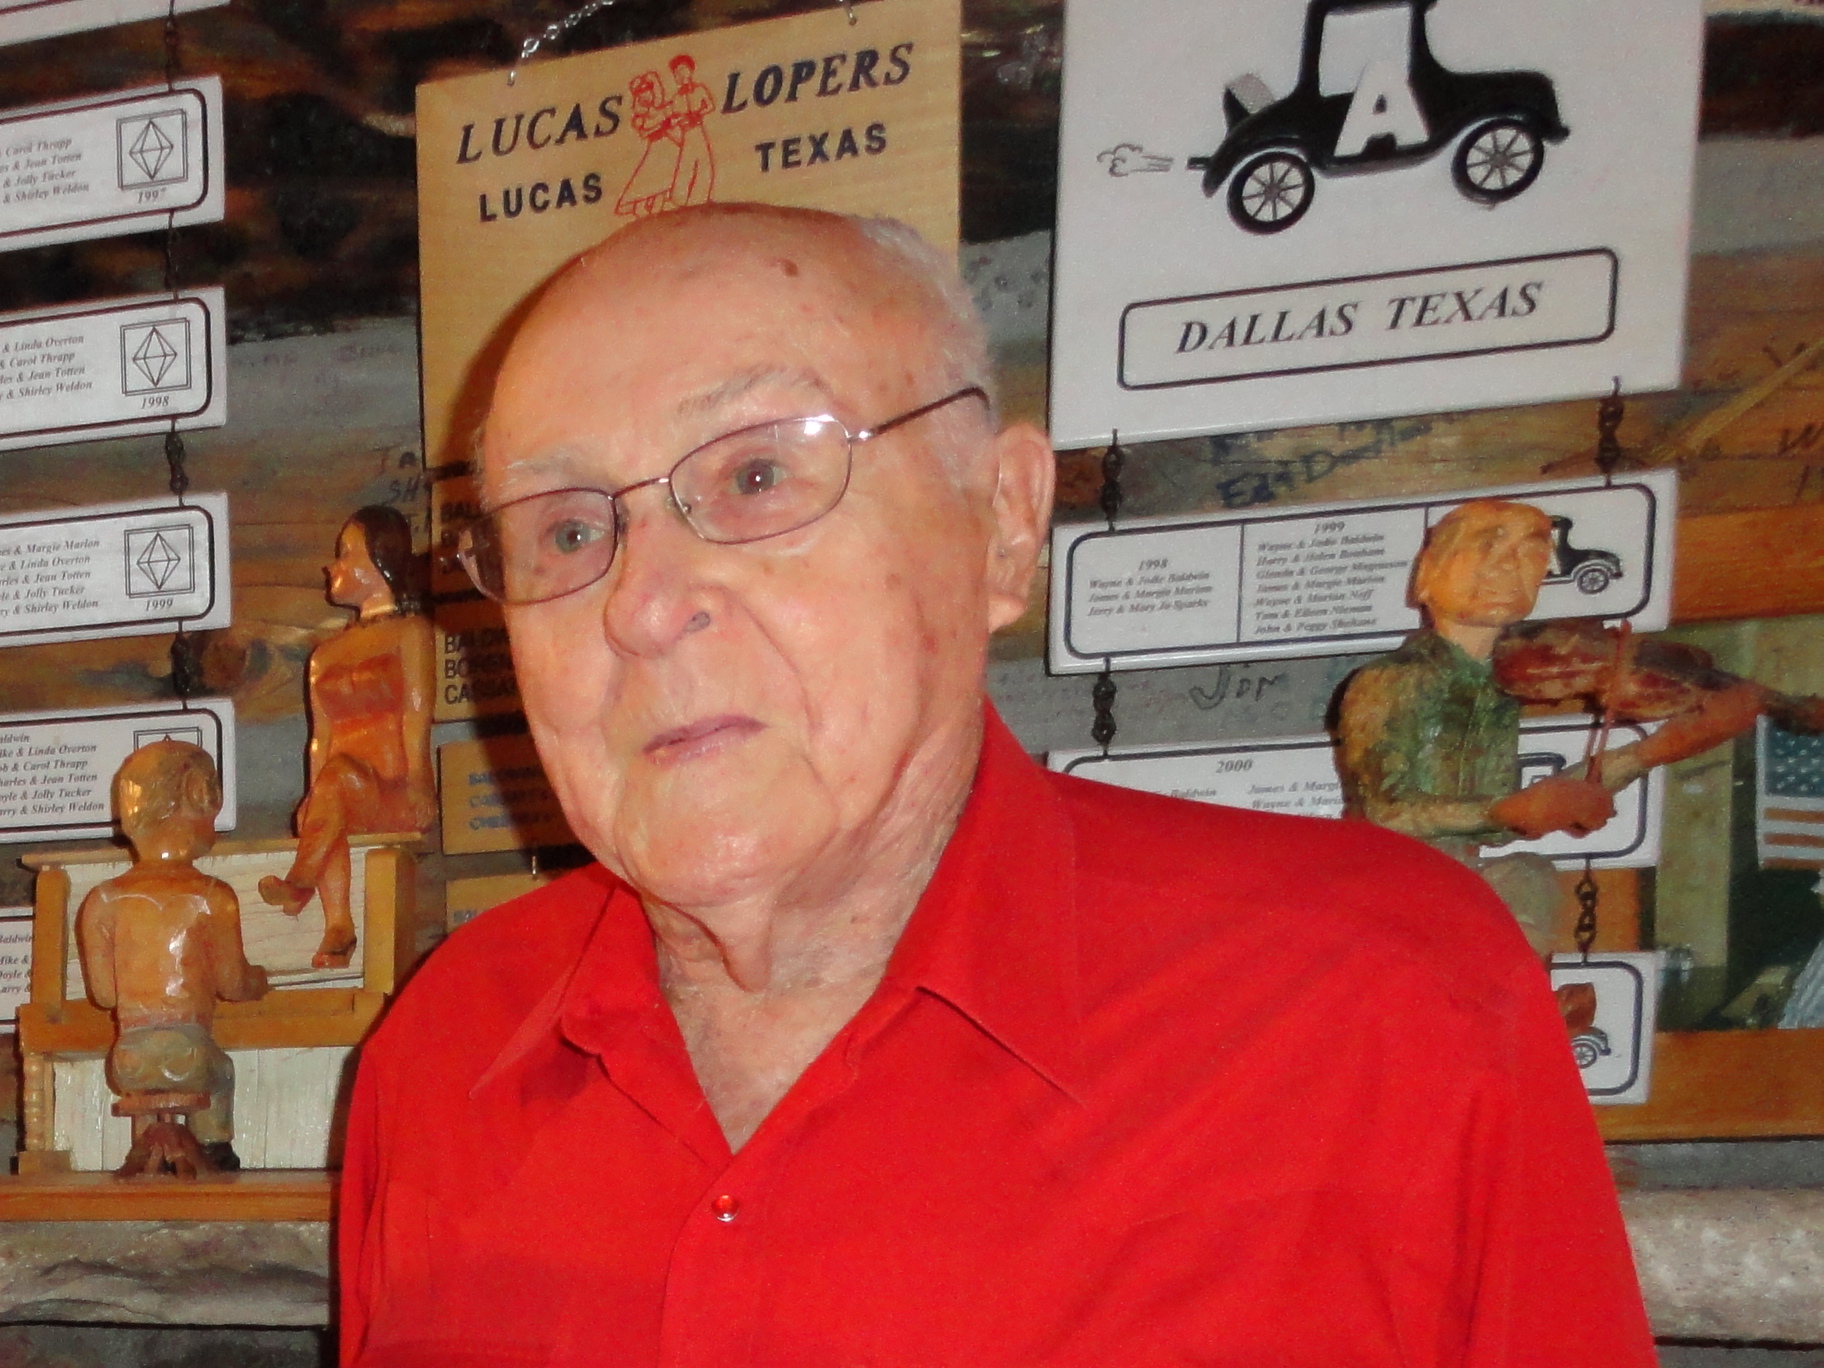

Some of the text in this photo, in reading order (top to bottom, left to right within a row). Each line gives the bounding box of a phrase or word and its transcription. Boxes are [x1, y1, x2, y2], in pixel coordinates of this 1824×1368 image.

[454, 42, 915, 165] LUCAS LOPERS
[478, 122, 889, 223] LUCAS TEXAS
[1174, 280, 1543, 355] DALLAS TEXAS
[16, 746, 24, 757] &
[28, 743, 58, 757] Linda
[57, 743, 97, 754] Overton
[11, 762, 19, 772] &
[23, 760, 50, 771] Carol
[54, 759, 88, 770] Thrapp
[1215, 758, 1254, 774] 2000
[29, 775, 38, 785] &
[40, 775, 64, 784] Jean
[68, 773, 98, 783] Totten
[20, 790, 28, 801] &
[31, 789, 55, 800] Jolly
[59, 787, 92, 798] Tucker
[20, 805, 28, 815] &
[31, 803, 66, 815] Shirley
[69, 801, 104, 812] Weldon
